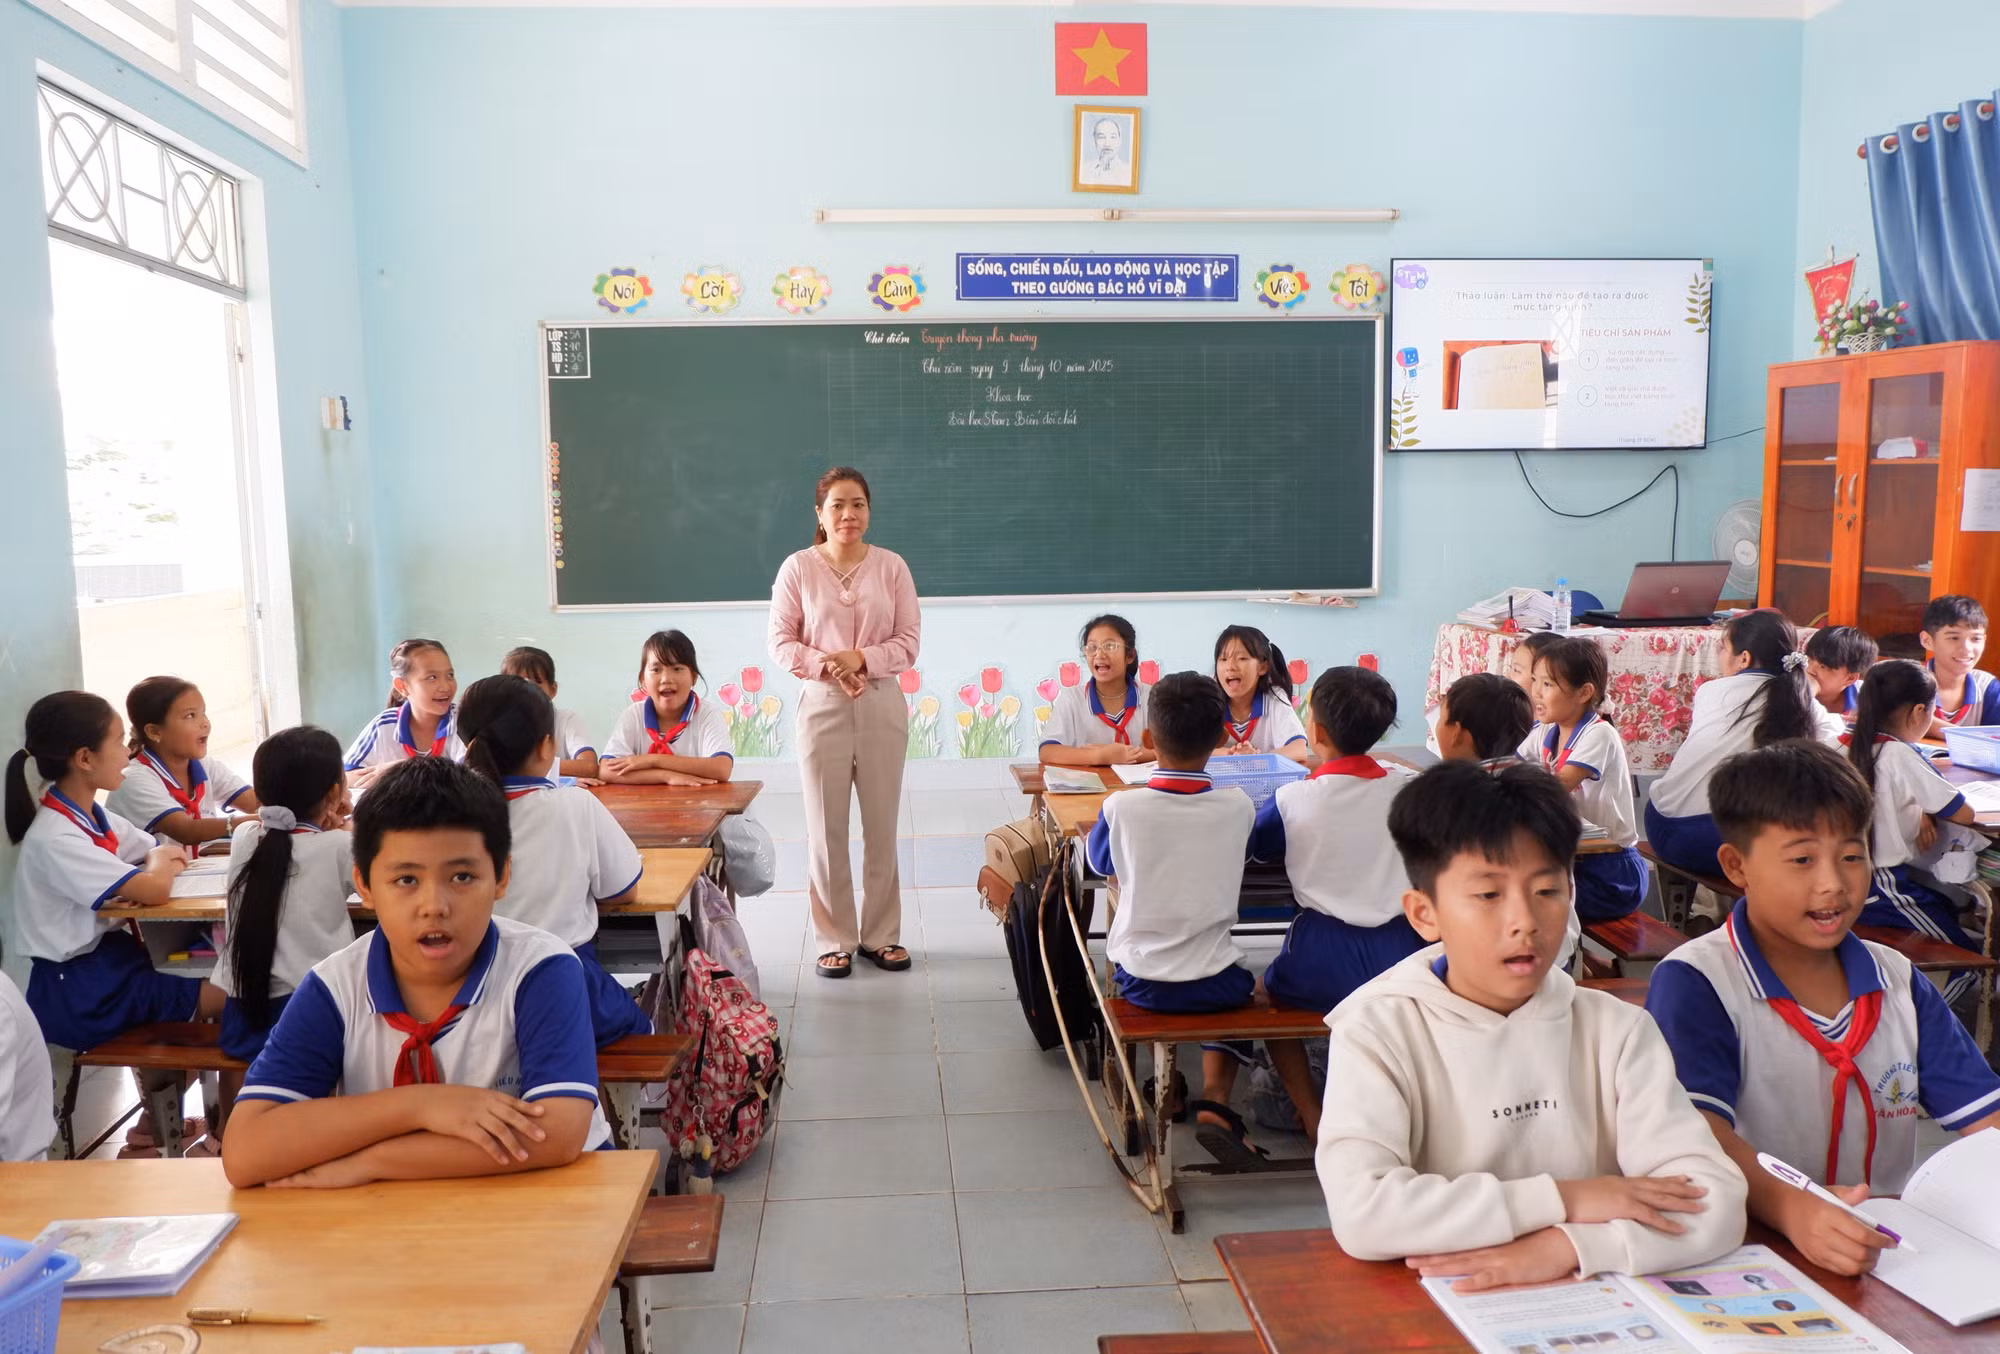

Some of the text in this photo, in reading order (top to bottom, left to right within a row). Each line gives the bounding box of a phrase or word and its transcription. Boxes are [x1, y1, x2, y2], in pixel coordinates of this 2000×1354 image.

[967, 258, 1229, 279] SỐNG, CHIẾN ĐẤU, LAO ĐỘNG VÀ HỌC TẬP
[613, 282, 636, 300] Nói
[790, 282, 817, 305] Hay
[1012, 277, 1187, 297] THEO GƯƠNG BÁC HỒ VĨ ĐẠI
[1349, 277, 1369, 298] Tốt
[1612, 292, 1621, 300] ra
[1019, 356, 1044, 380] tháng
[1048, 359, 1062, 373] 10
[1066, 363, 1085, 373] năm
[1088, 359, 1114, 373] 2025
[985, 385, 1012, 402] Khoa
[1492, 1099, 1557, 1119] SONNETI
